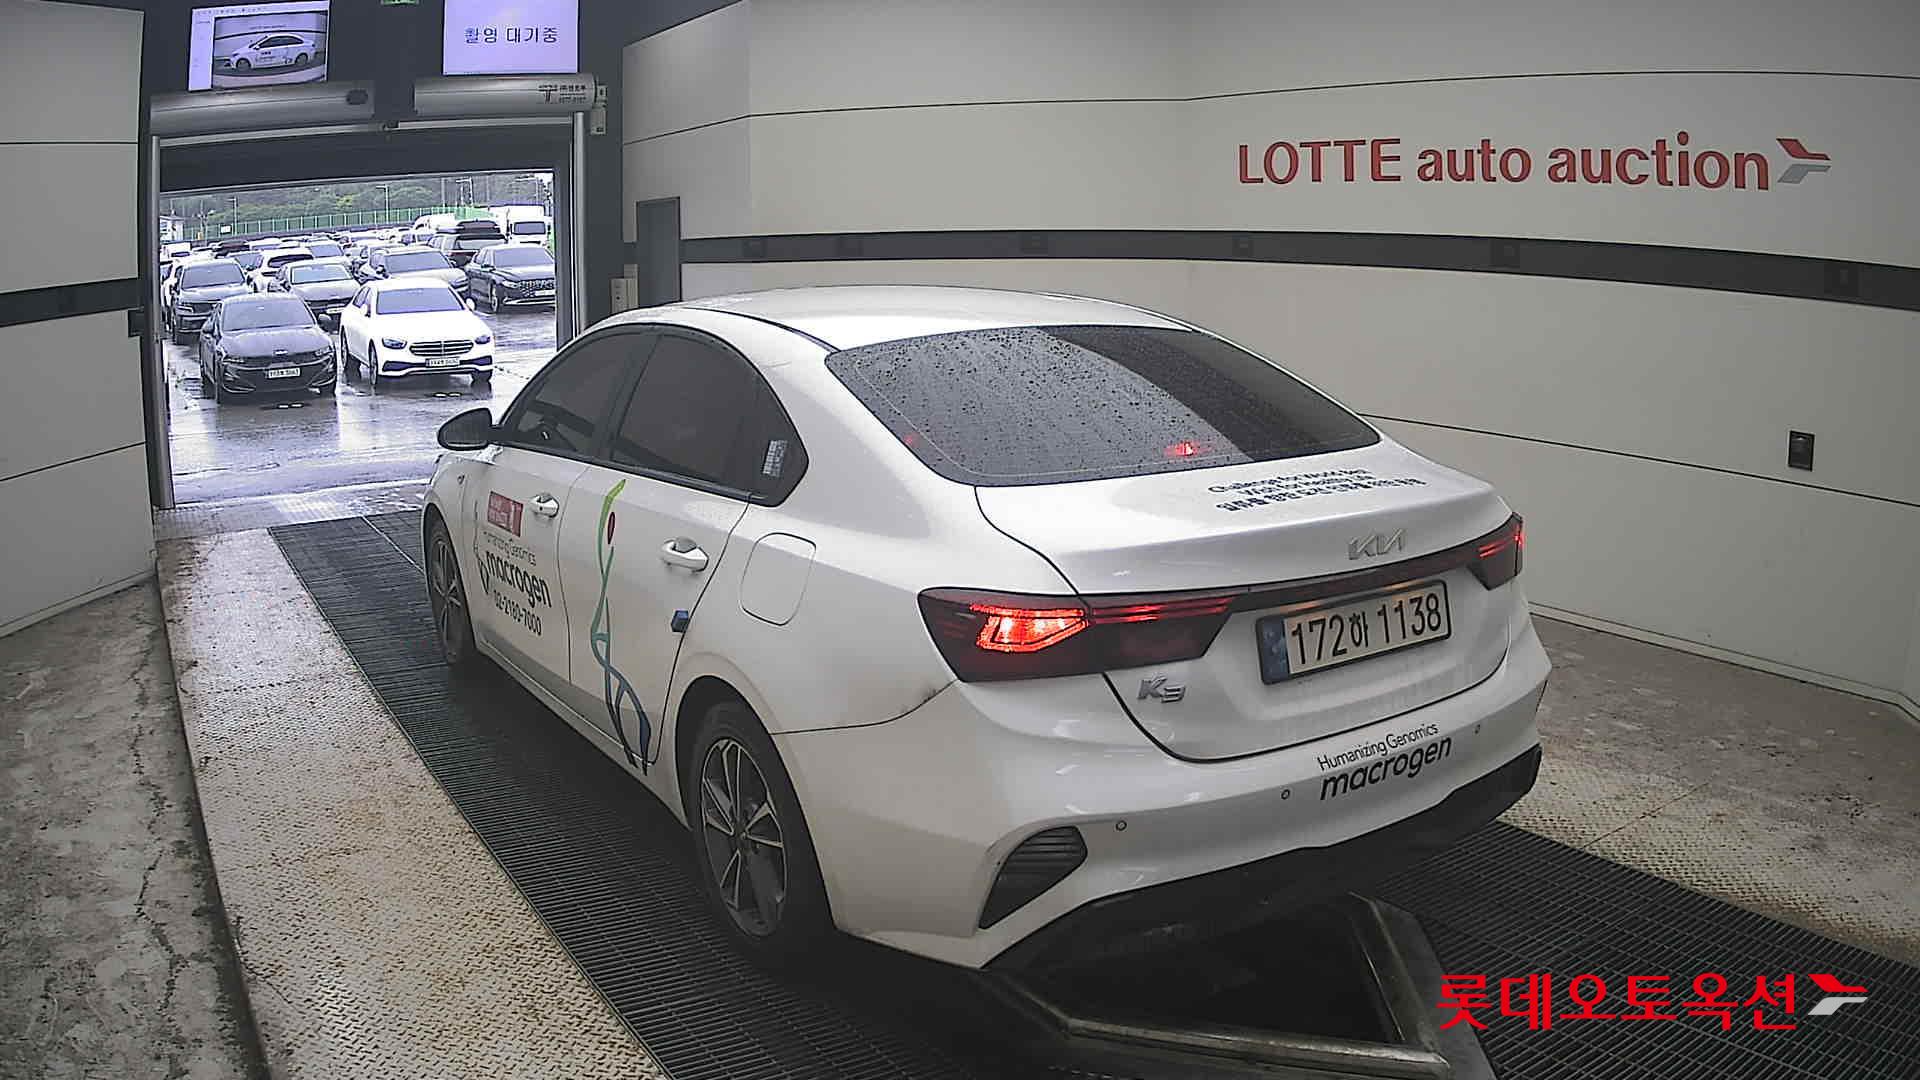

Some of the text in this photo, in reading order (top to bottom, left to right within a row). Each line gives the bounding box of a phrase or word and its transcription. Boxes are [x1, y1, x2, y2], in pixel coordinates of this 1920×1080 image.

[506, 27, 559, 44] 대기중
[1239, 131, 1770, 190] LOTTE auto auction
[486, 550, 552, 608] macrogen
[1291, 612, 1369, 665] 172하
[1377, 593, 1442, 644] 1138
[1137, 675, 1186, 703] K3
[1317, 723, 1439, 771] Humanizing Genomics
[1320, 736, 1452, 801] macrogen
